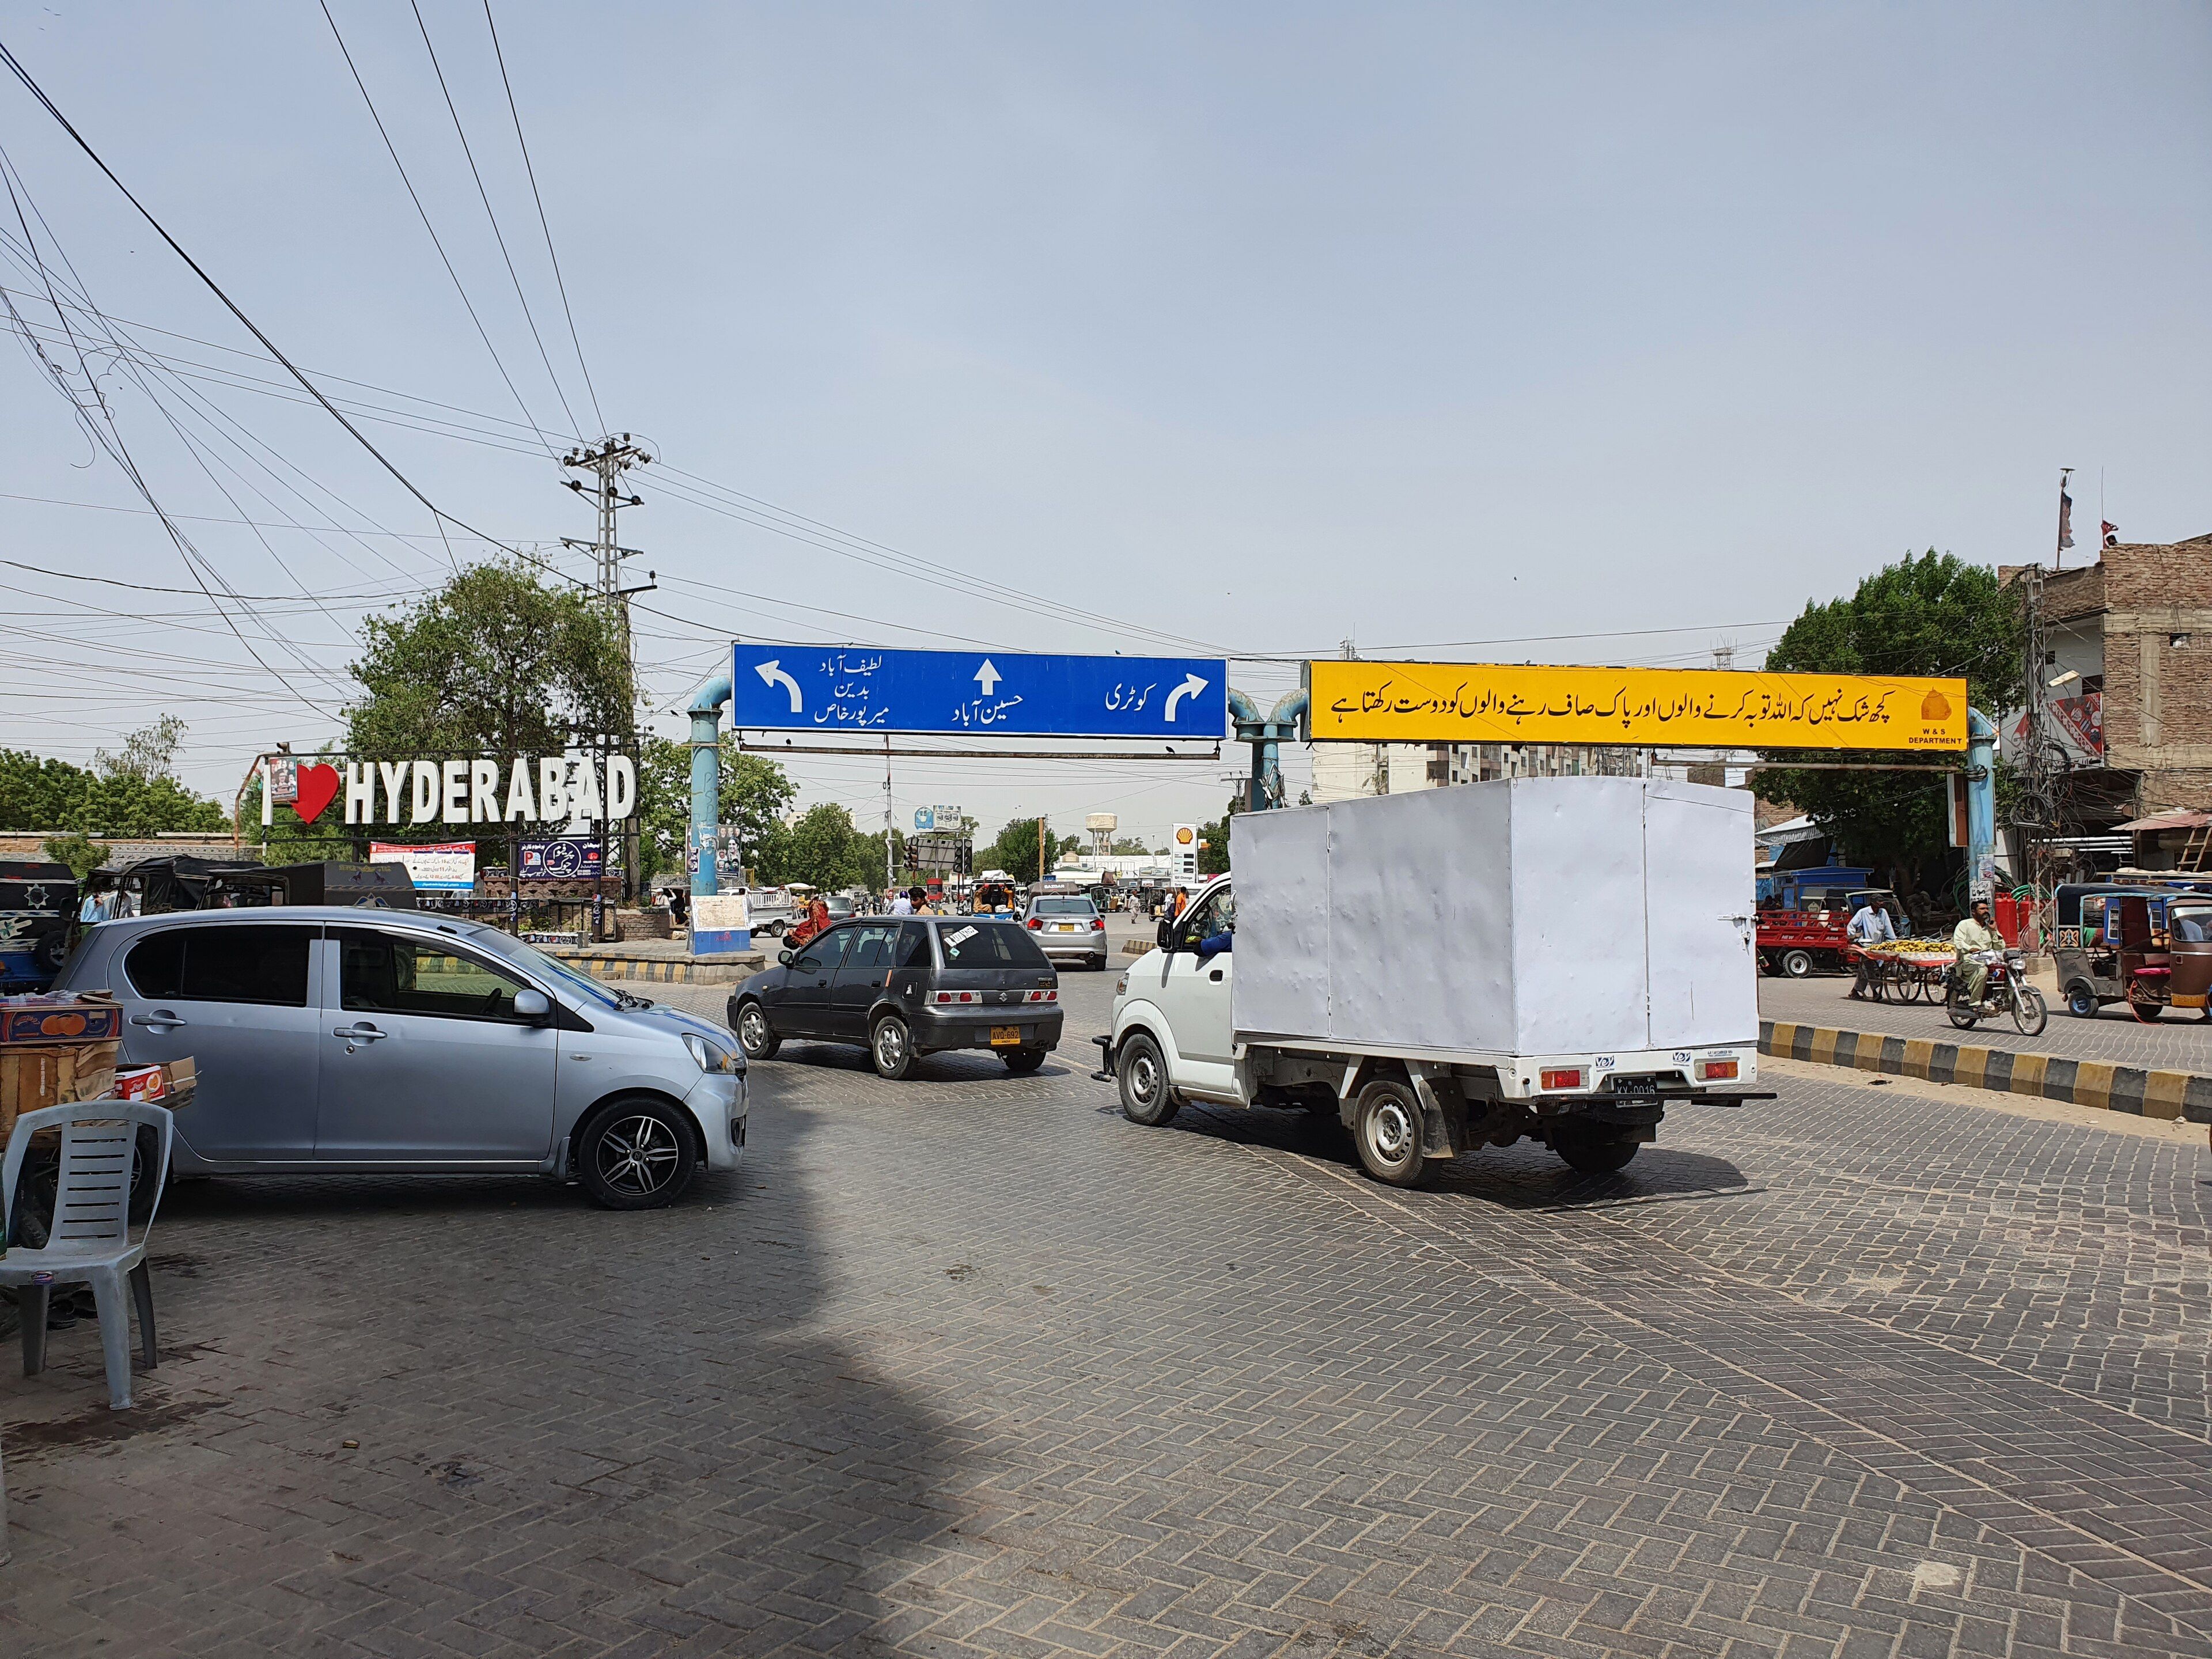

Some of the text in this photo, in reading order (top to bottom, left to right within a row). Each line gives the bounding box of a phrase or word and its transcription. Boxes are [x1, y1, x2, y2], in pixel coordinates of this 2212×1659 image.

[819, 654, 882, 676] لطیف آباد
[834, 681, 870, 700] بدین
[1105, 681, 1156, 712] کوٹری
[1331, 680, 1896, 729] کچھ شک نہیں کہ اللہ توبہ کرنے والوں اور پاک صاف رہنے والوں کو دوست رکھتا ہے
[951, 694, 1024, 727] حسین آباد
[346, 755, 636, 824] HYDERABAD
[993, 1031, 1018, 1040] AVQ-692
